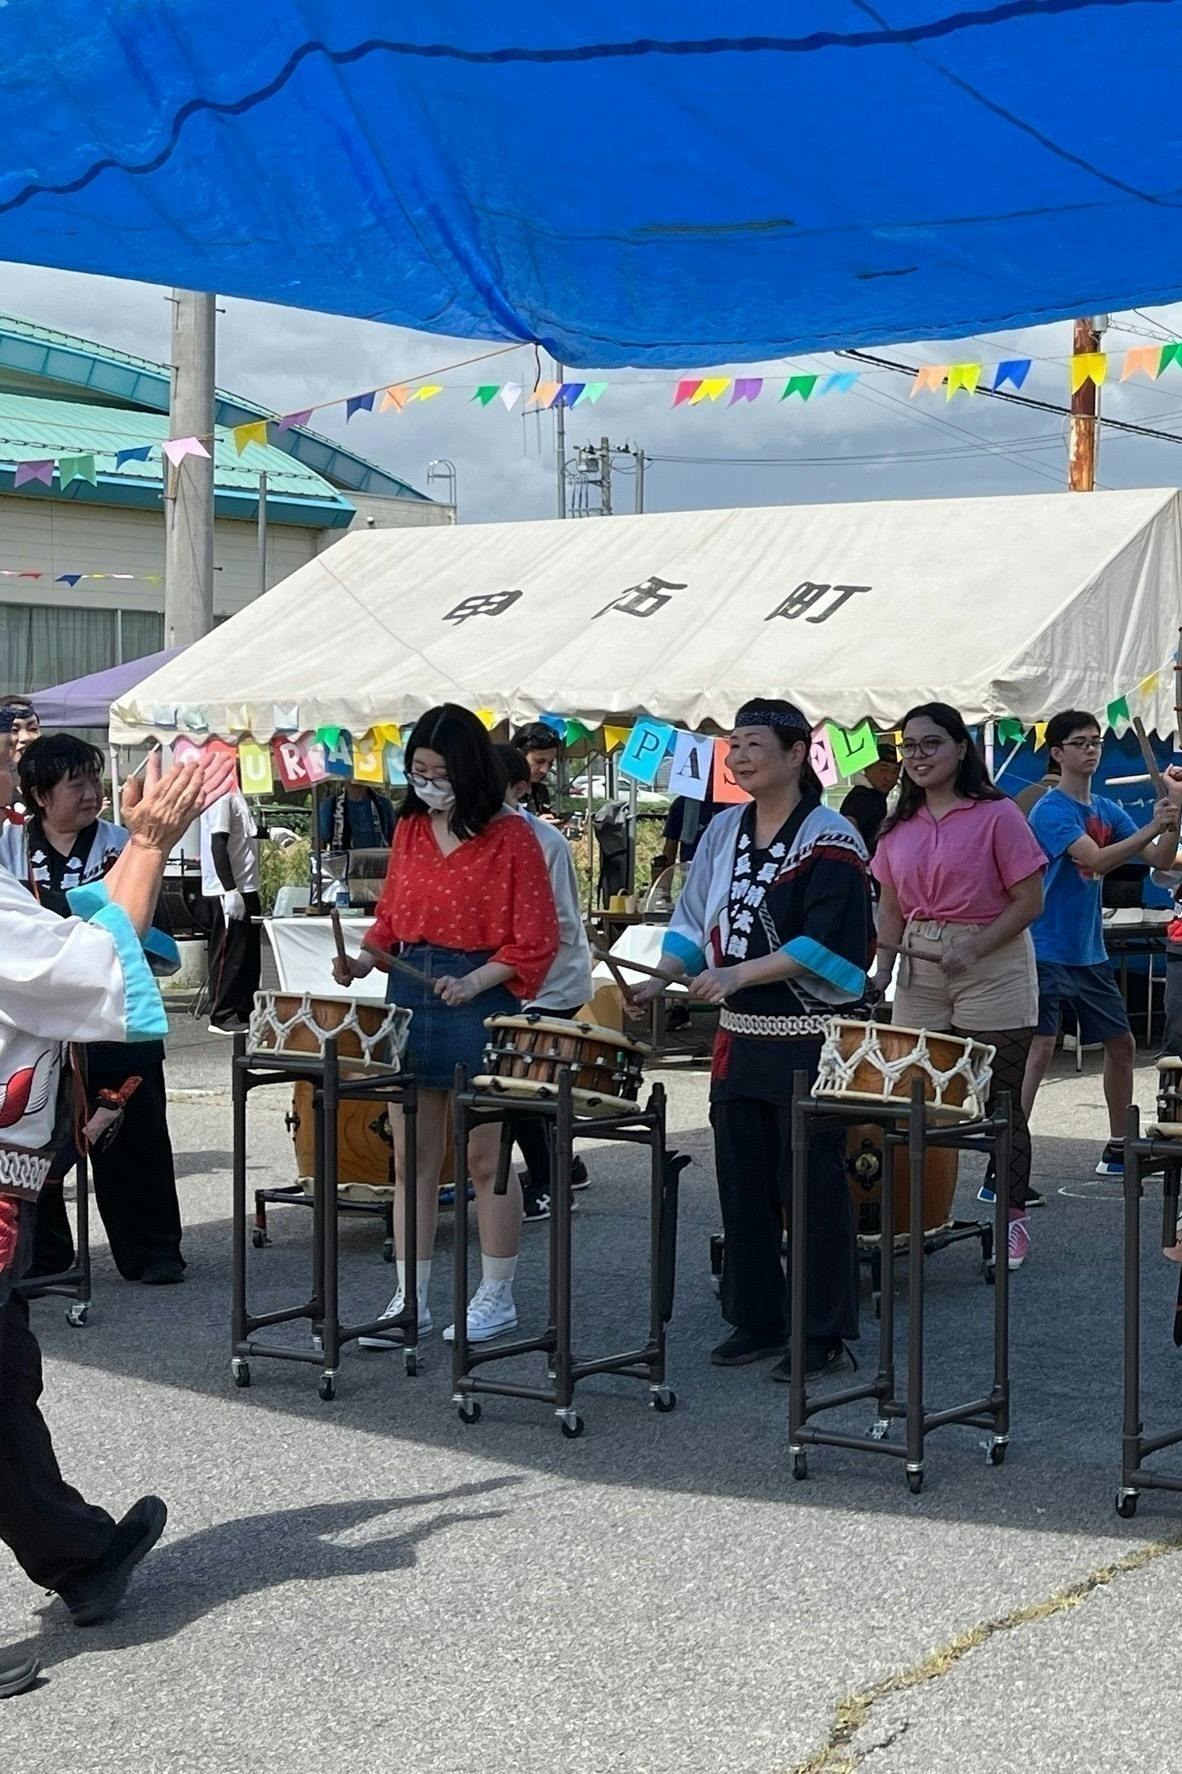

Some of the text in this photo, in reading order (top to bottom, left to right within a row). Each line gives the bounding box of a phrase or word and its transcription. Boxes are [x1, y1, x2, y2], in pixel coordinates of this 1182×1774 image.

[441, 576, 872, 626] 甲西町
[632, 728, 865, 785] PAEL
